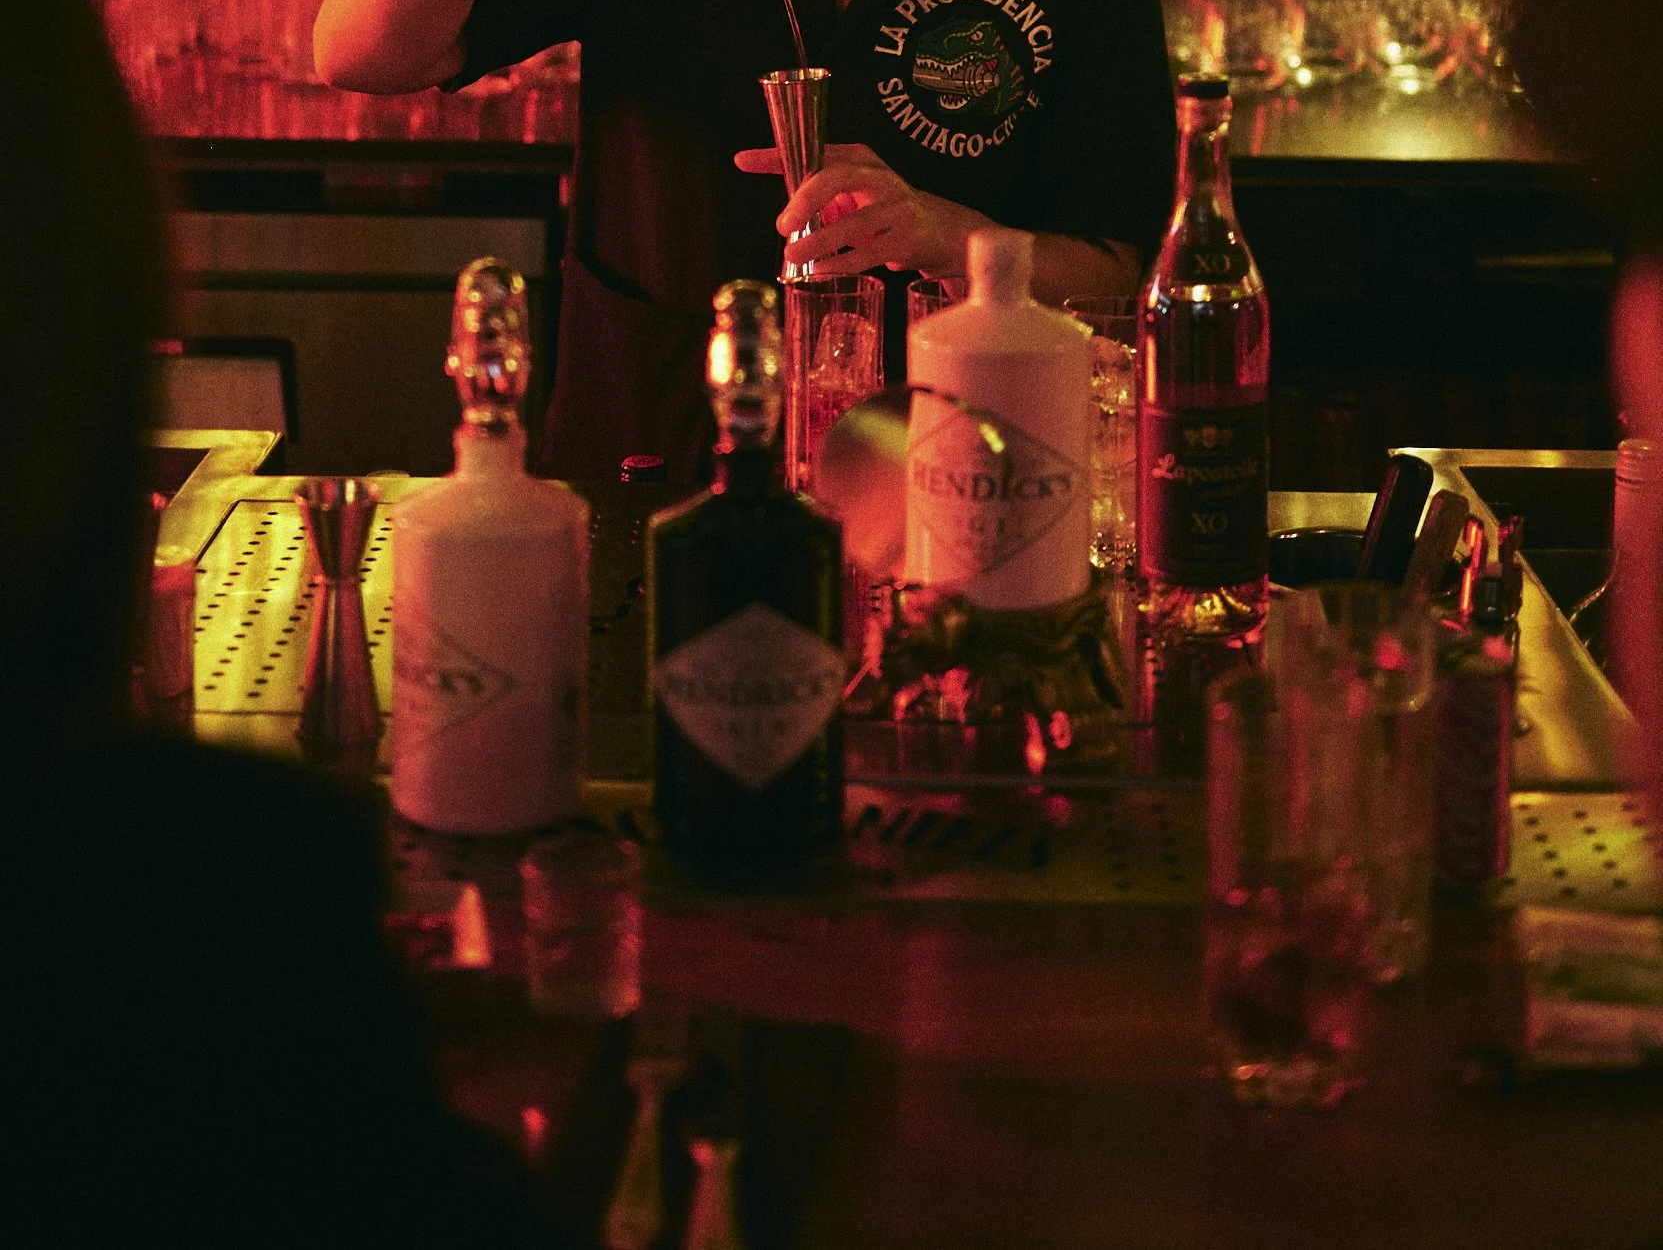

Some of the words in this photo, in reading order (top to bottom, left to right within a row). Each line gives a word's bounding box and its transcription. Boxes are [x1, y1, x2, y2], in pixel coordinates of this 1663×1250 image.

[874, 25, 910, 56] LA
[1193, 253, 1231, 275] XO
[1190, 513, 1229, 534] XO
